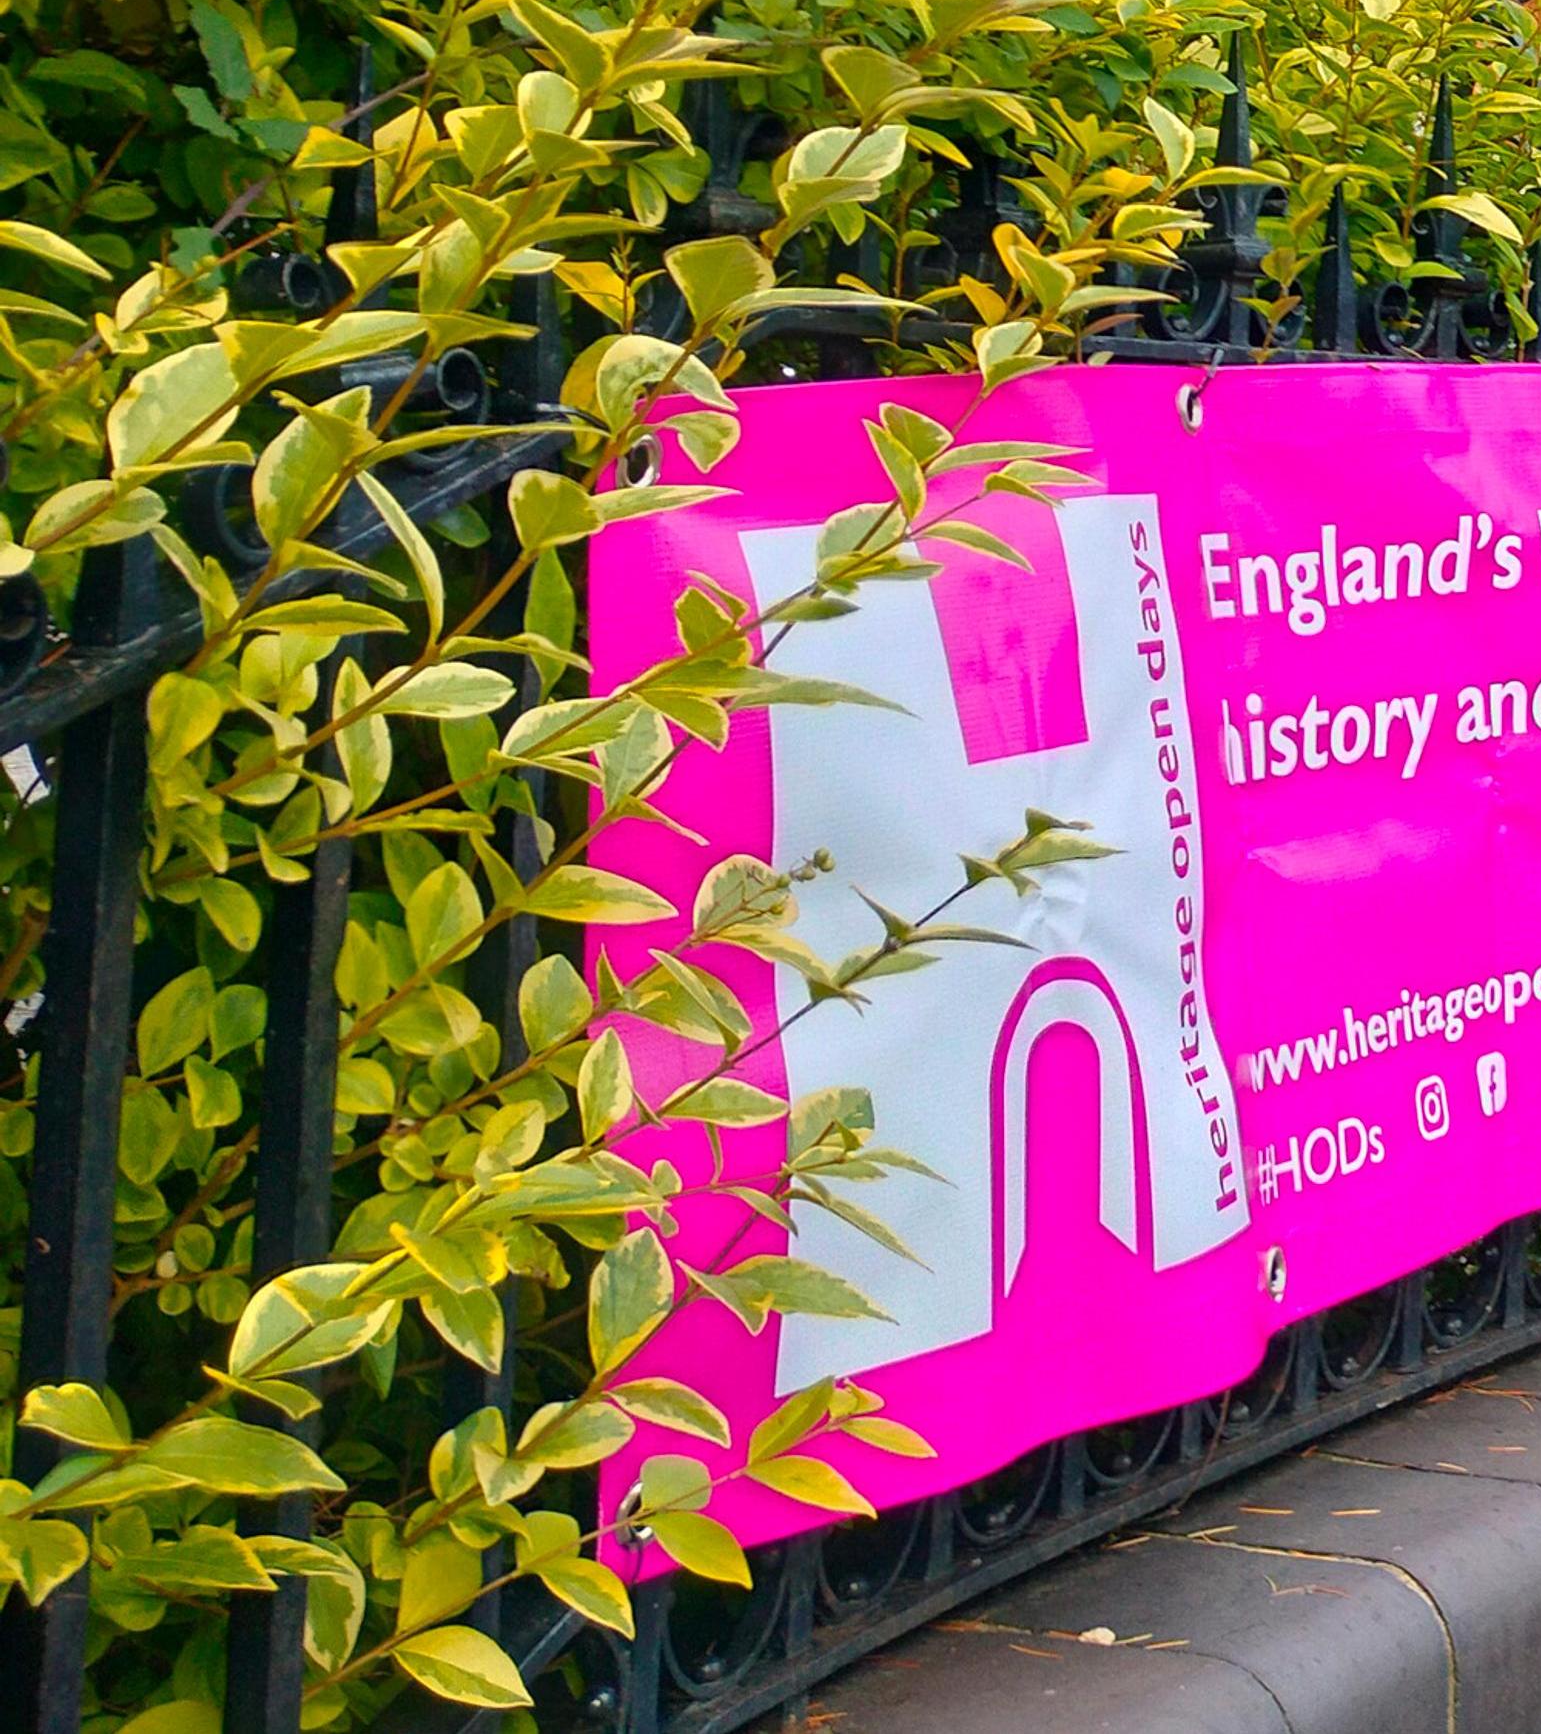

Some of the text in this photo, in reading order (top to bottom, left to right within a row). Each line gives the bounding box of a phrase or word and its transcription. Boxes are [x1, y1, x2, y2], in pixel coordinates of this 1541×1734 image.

[1200, 513, 1522, 636] England's
[1220, 693, 1439, 786] history
[1129, 520, 1239, 1213] heritage open days
[1256, 1116, 1386, 1208] #HODs
